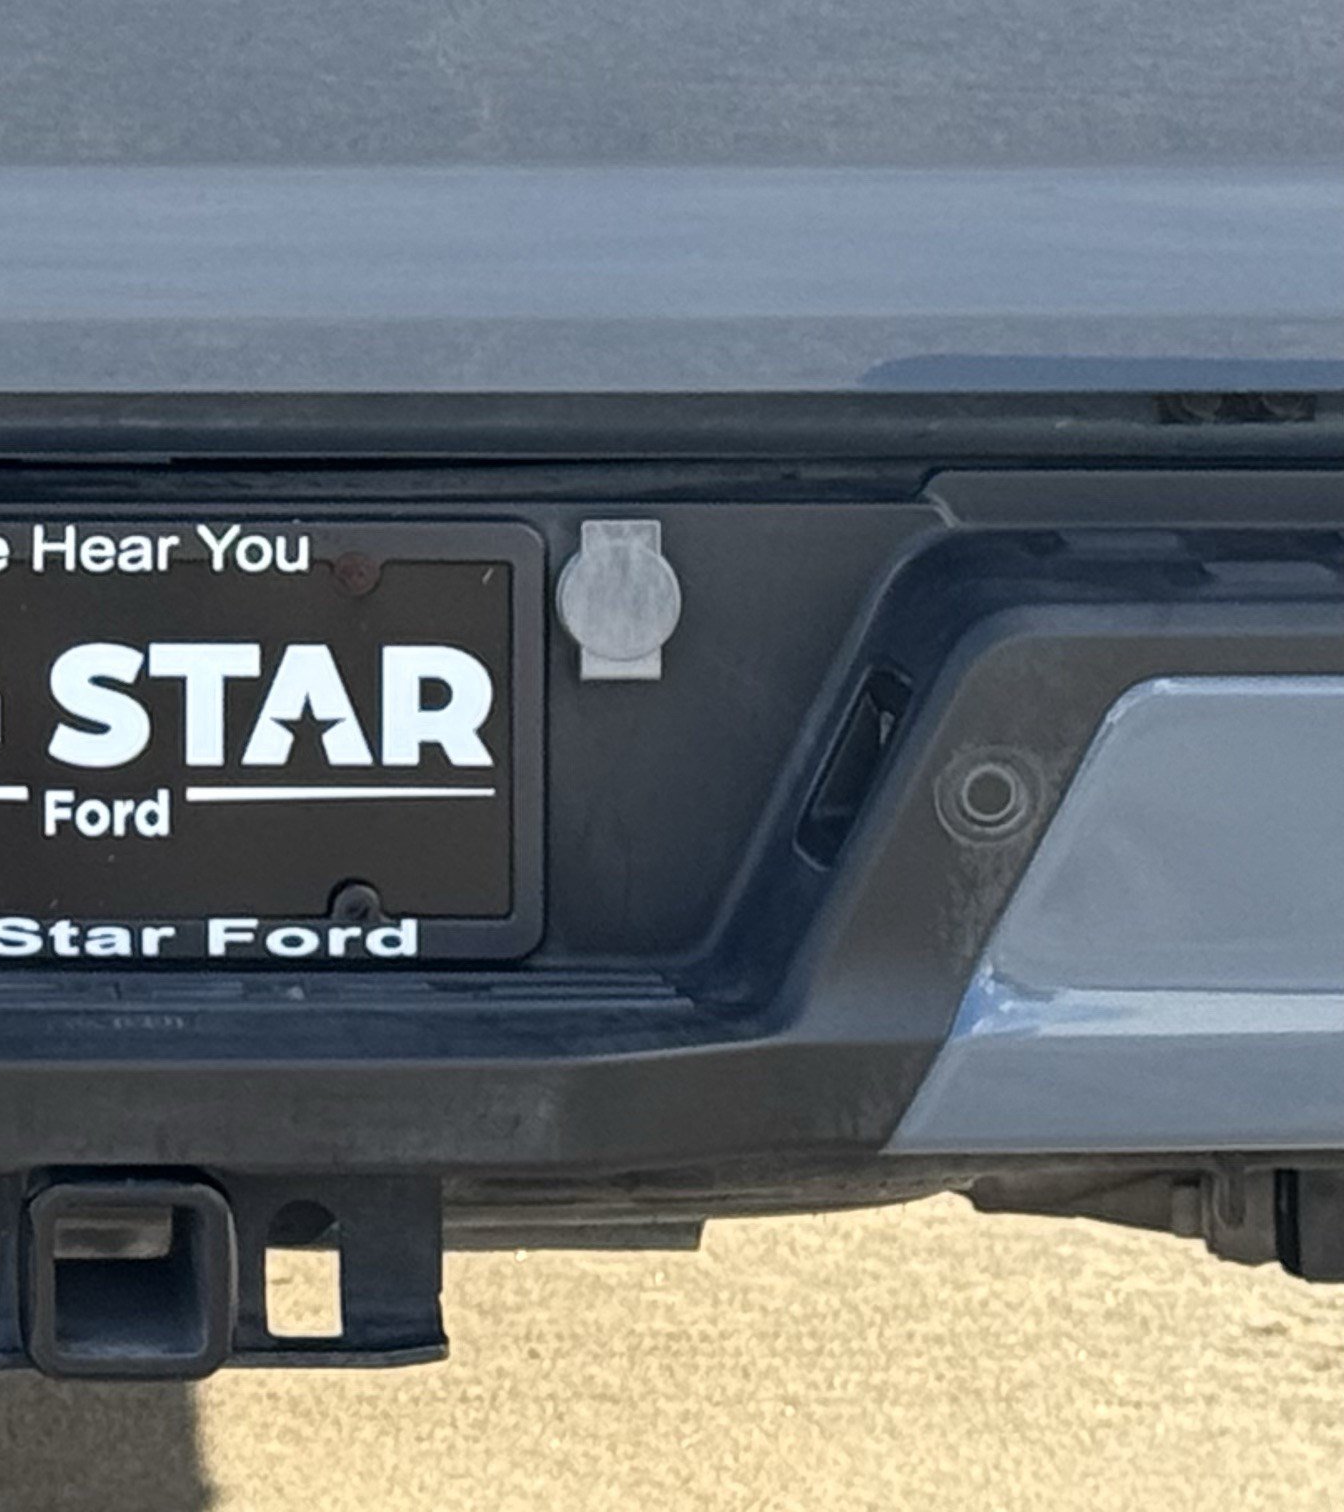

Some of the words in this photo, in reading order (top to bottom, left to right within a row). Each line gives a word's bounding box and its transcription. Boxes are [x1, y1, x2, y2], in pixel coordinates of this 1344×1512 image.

[32, 524, 180, 572] Hear
[196, 524, 310, 572] You
[47, 641, 495, 768] STAR
[43, 787, 170, 837] Ford
[207, 917, 418, 957] Ford
